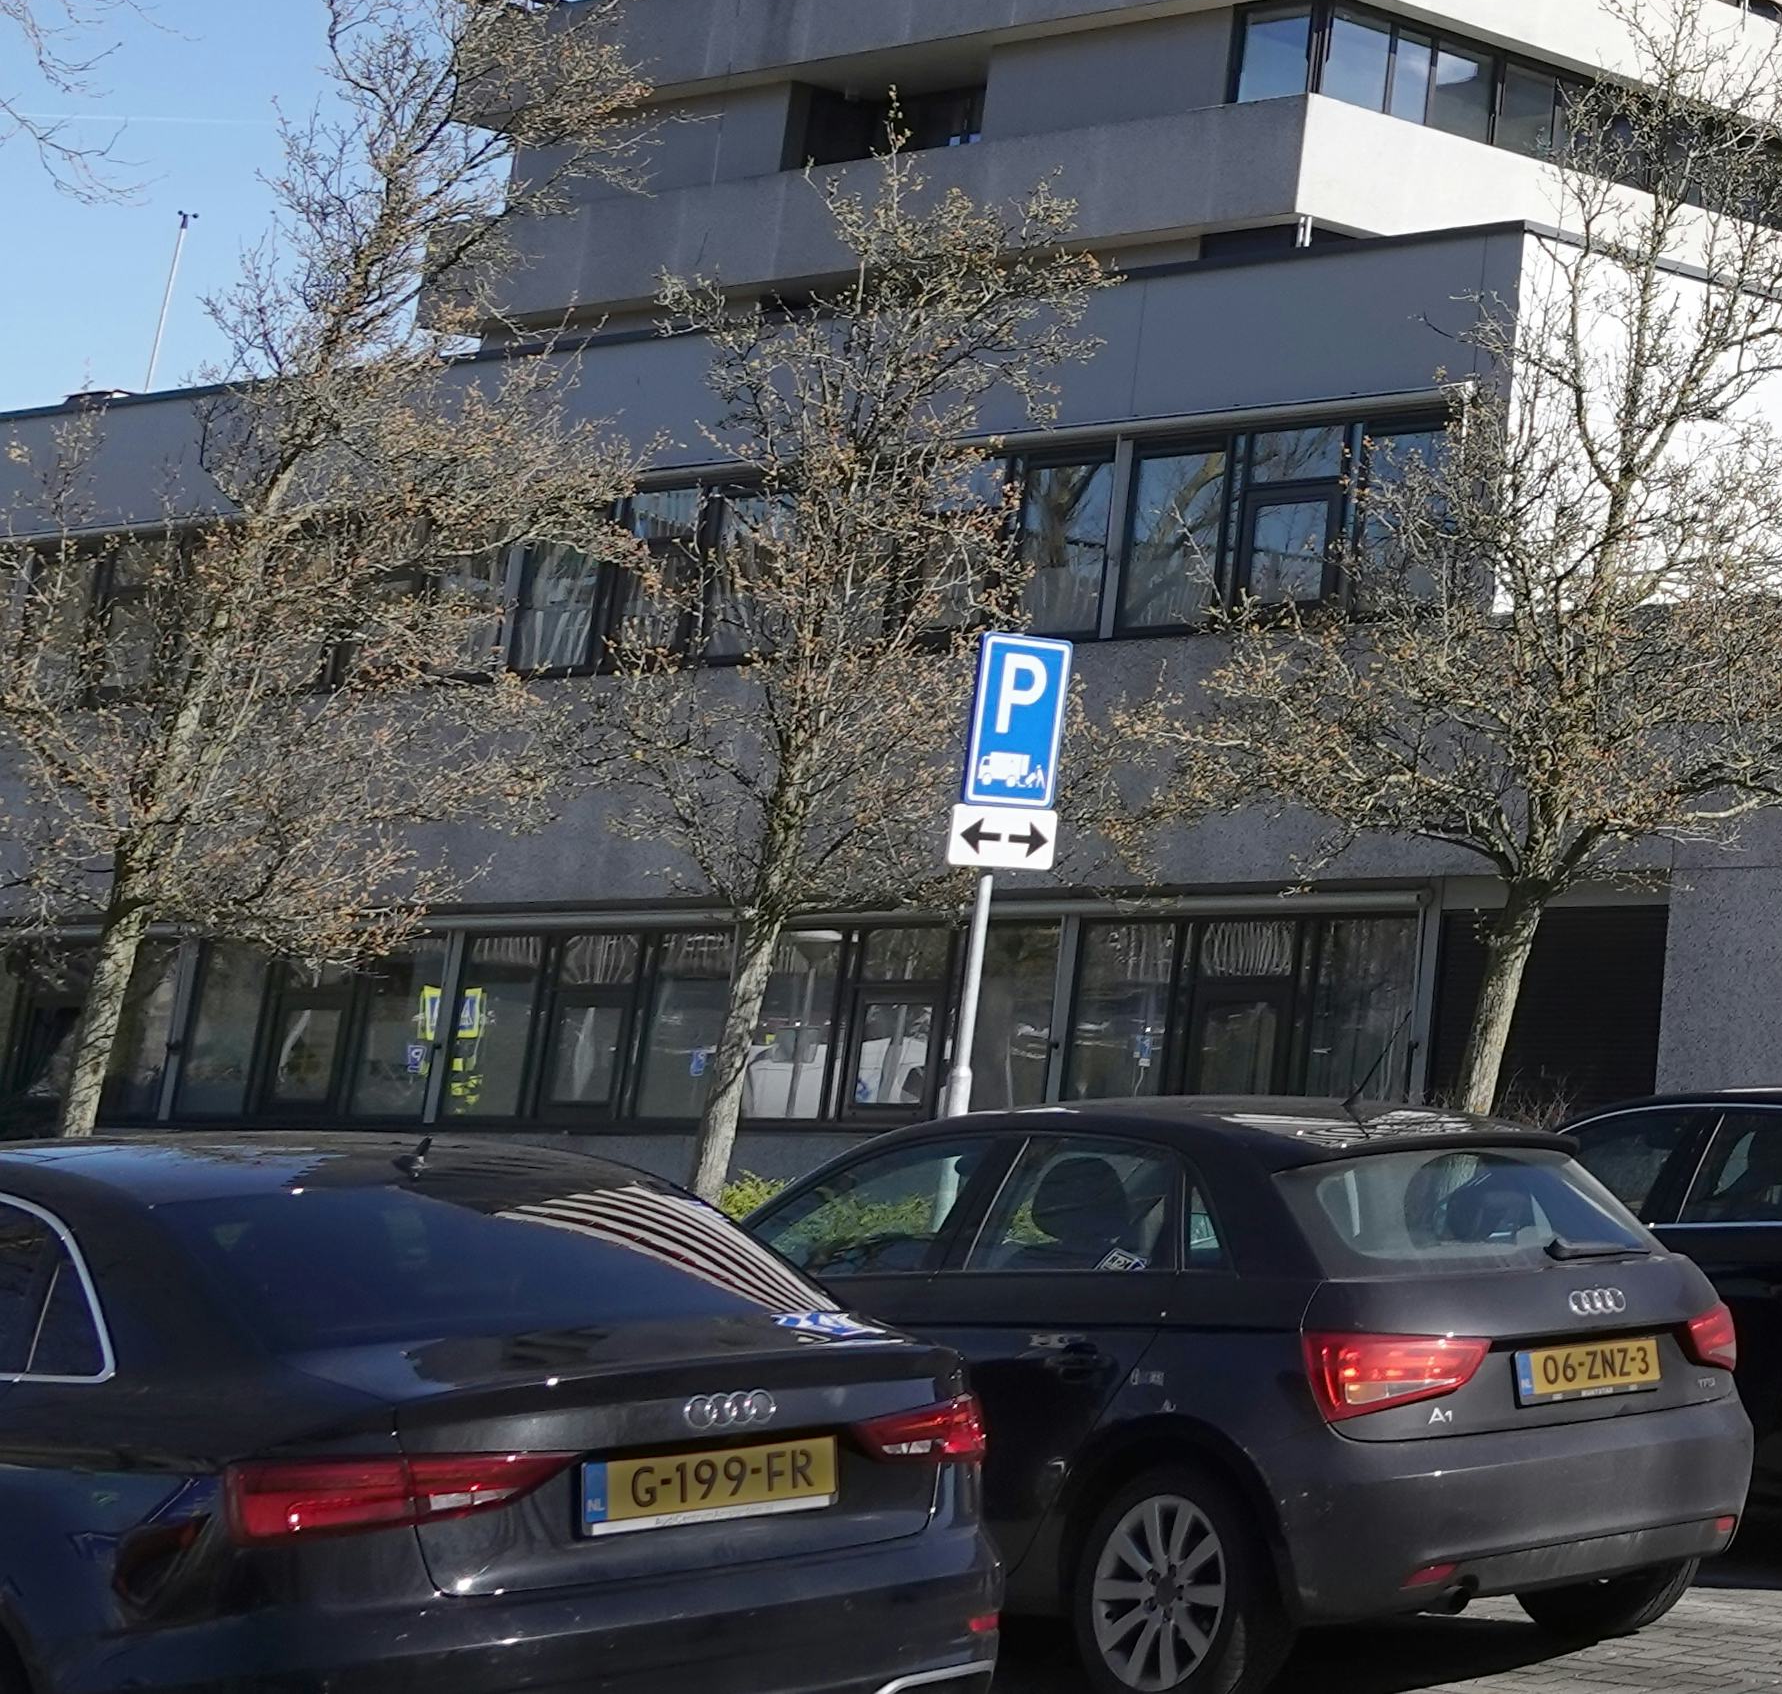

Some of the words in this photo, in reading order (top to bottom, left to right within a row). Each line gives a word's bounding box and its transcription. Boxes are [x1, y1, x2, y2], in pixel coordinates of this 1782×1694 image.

[995, 652, 1048, 734] P
[1543, 1346, 1650, 1385] 06-ZNZ-3
[1428, 1407, 1452, 1425] A1
[631, 1449, 815, 1507] G-199-FR
[586, 1497, 605, 1512] NL
